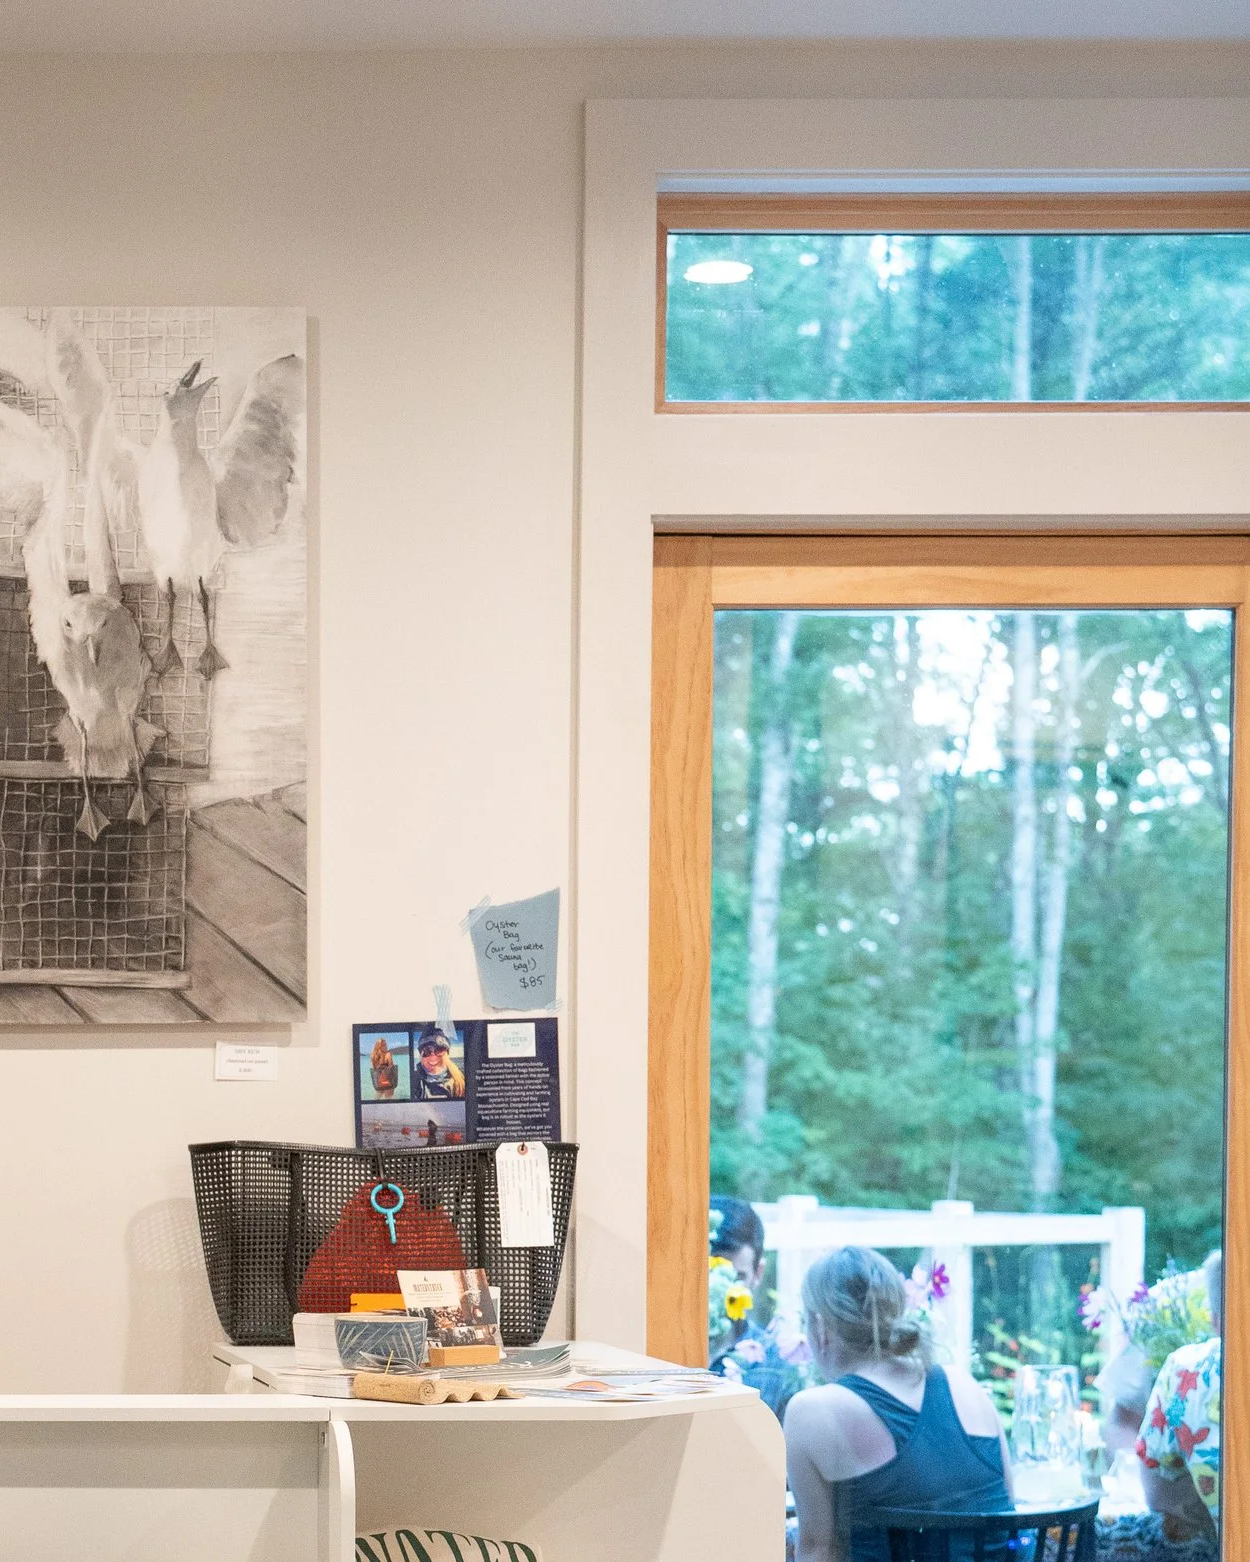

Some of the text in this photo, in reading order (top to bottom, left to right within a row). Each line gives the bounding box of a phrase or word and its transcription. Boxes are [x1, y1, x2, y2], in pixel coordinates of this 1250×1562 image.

[485, 920, 519, 933] Oyster
[503, 931, 520, 942] Bag
[485, 941, 544, 959] (our favorite
[514, 957, 537, 972] bag!)
[519, 975, 545, 989] $85
